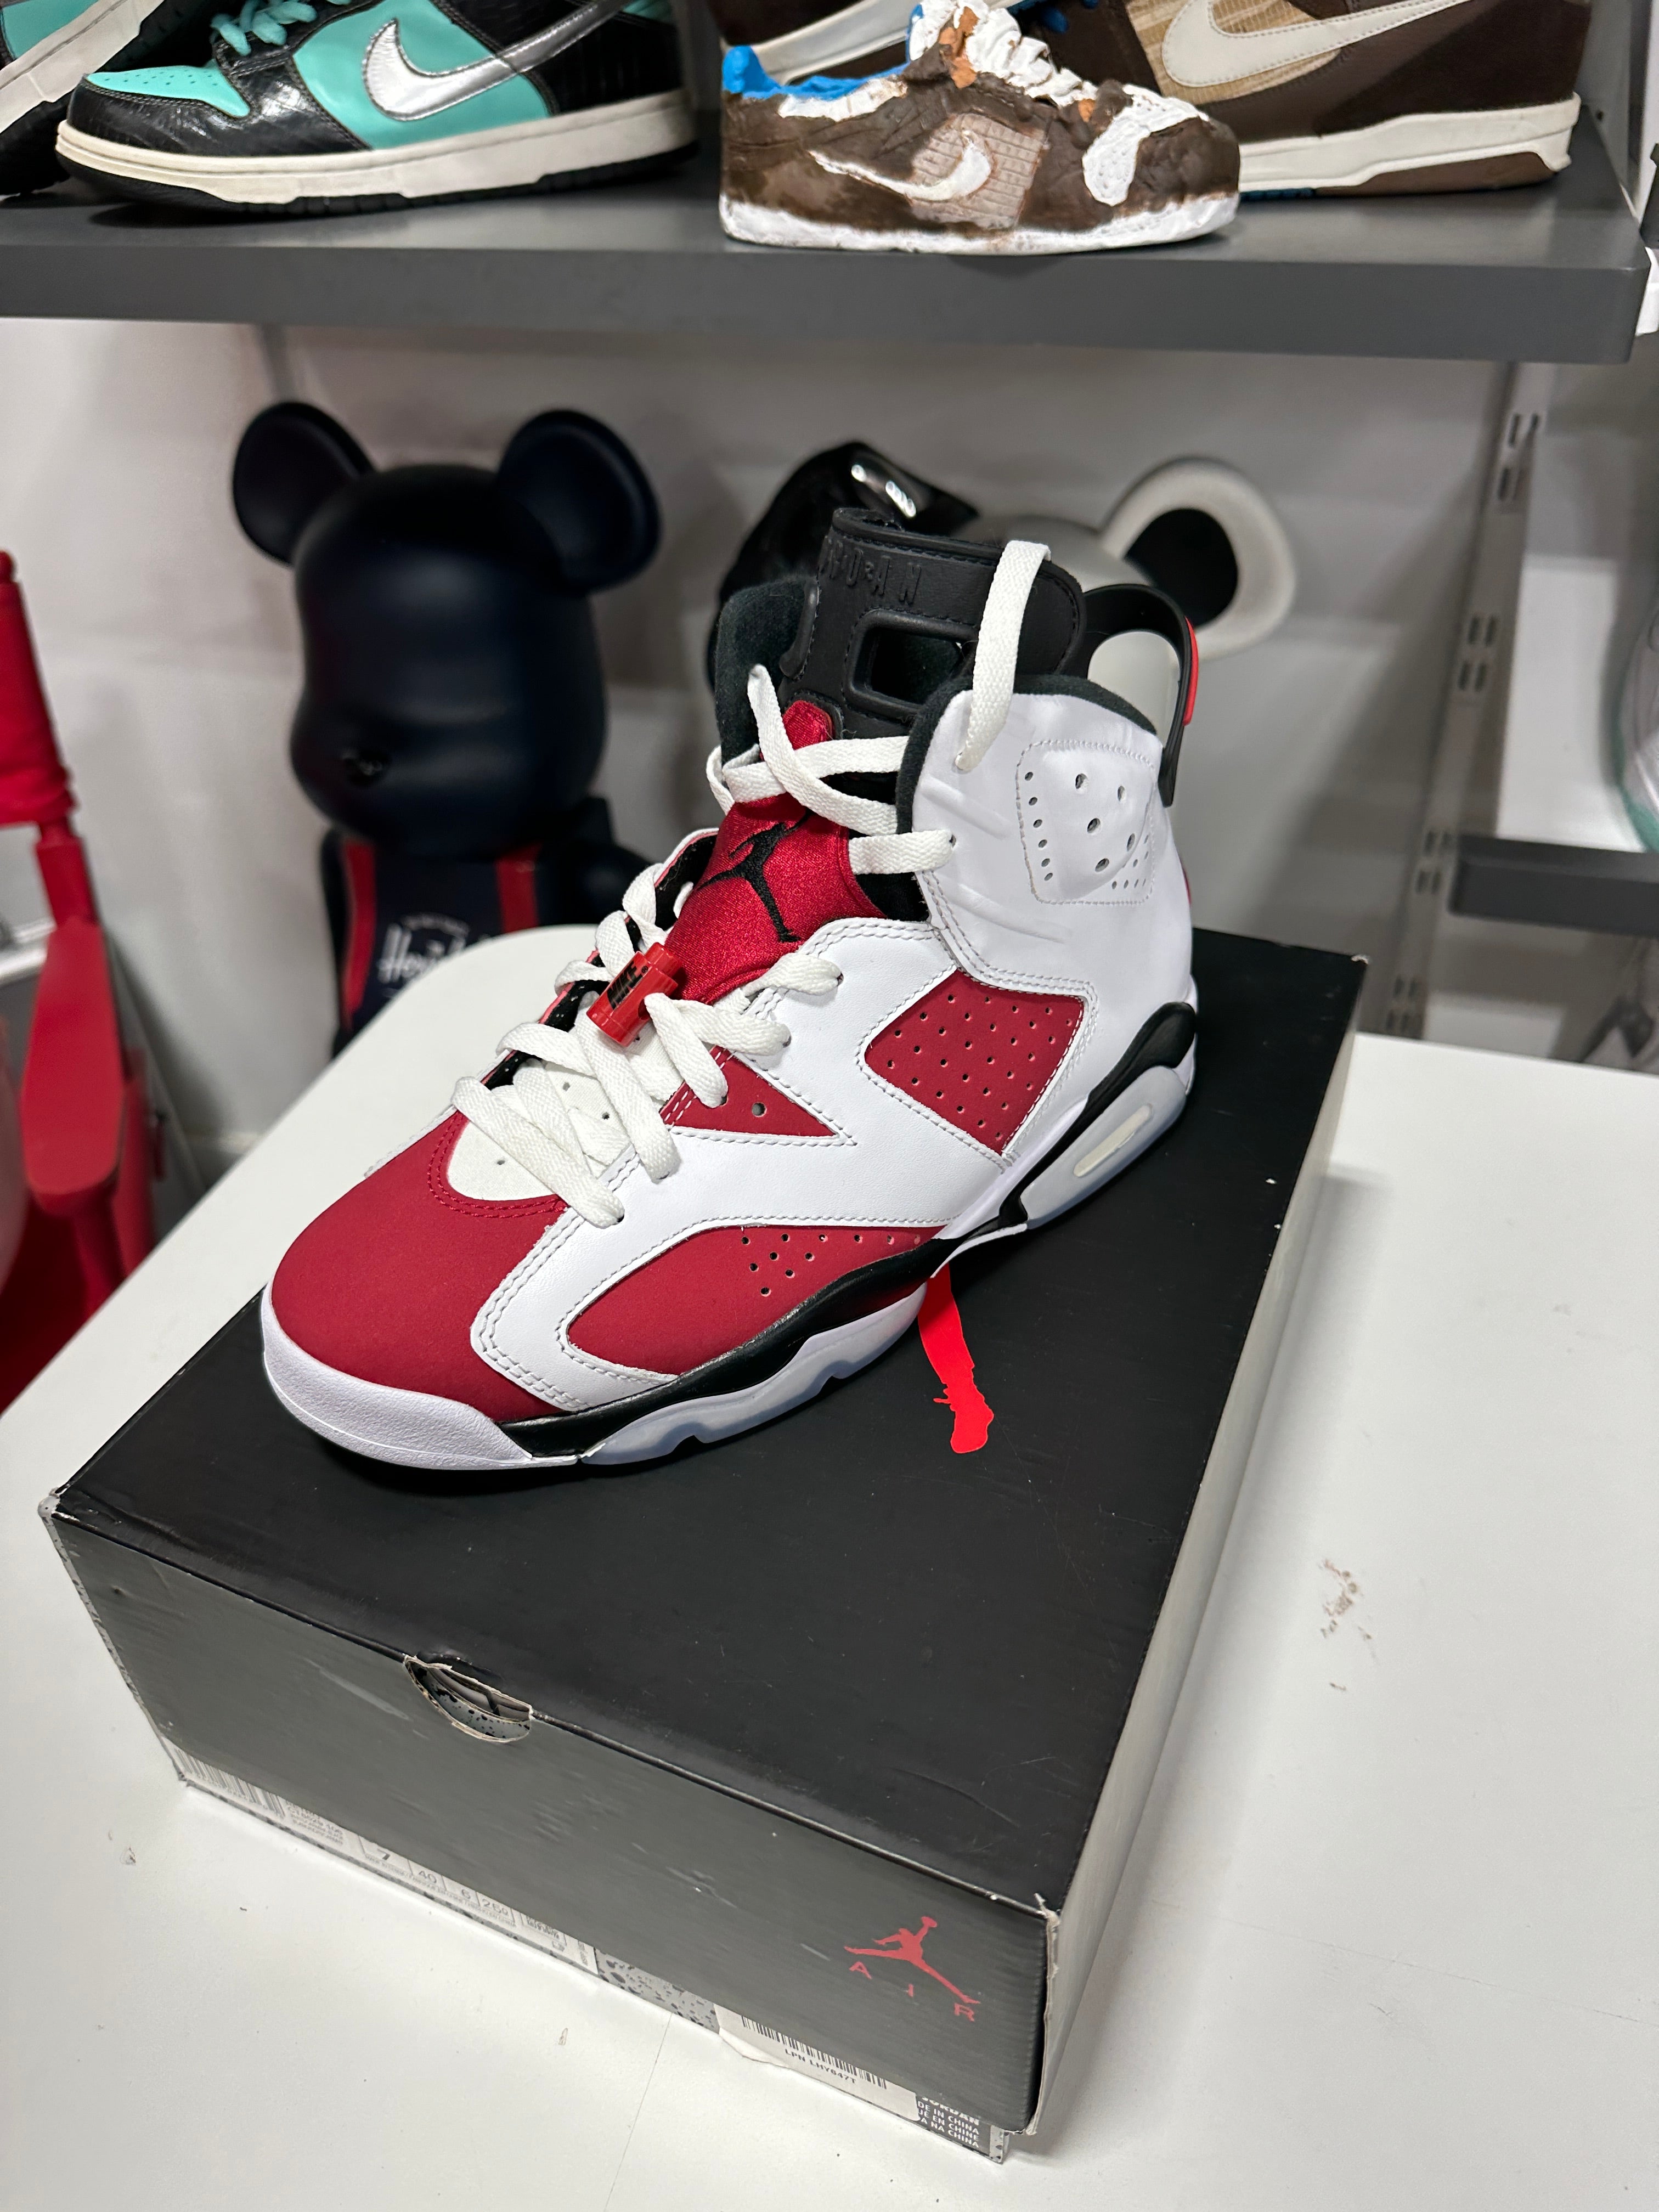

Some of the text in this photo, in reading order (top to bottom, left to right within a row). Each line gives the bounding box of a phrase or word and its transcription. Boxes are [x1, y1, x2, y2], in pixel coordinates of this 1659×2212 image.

[606, 960, 643, 1010] NIKE
[377, 1847, 391, 1861] 7
[419, 1869, 437, 1883] 40
[849, 1961, 975, 2022] AIR
[785, 2049, 805, 2062] LPN
[918, 2101, 930, 2111] DE
[934, 2108, 944, 2118] IN
[948, 2115, 979, 2135] CHINA
[933, 2115, 945, 2125] EN
[948, 2123, 979, 2141] CHINE
[931, 2121, 945, 2132] NA
[947, 2130, 979, 2148] CHINA
